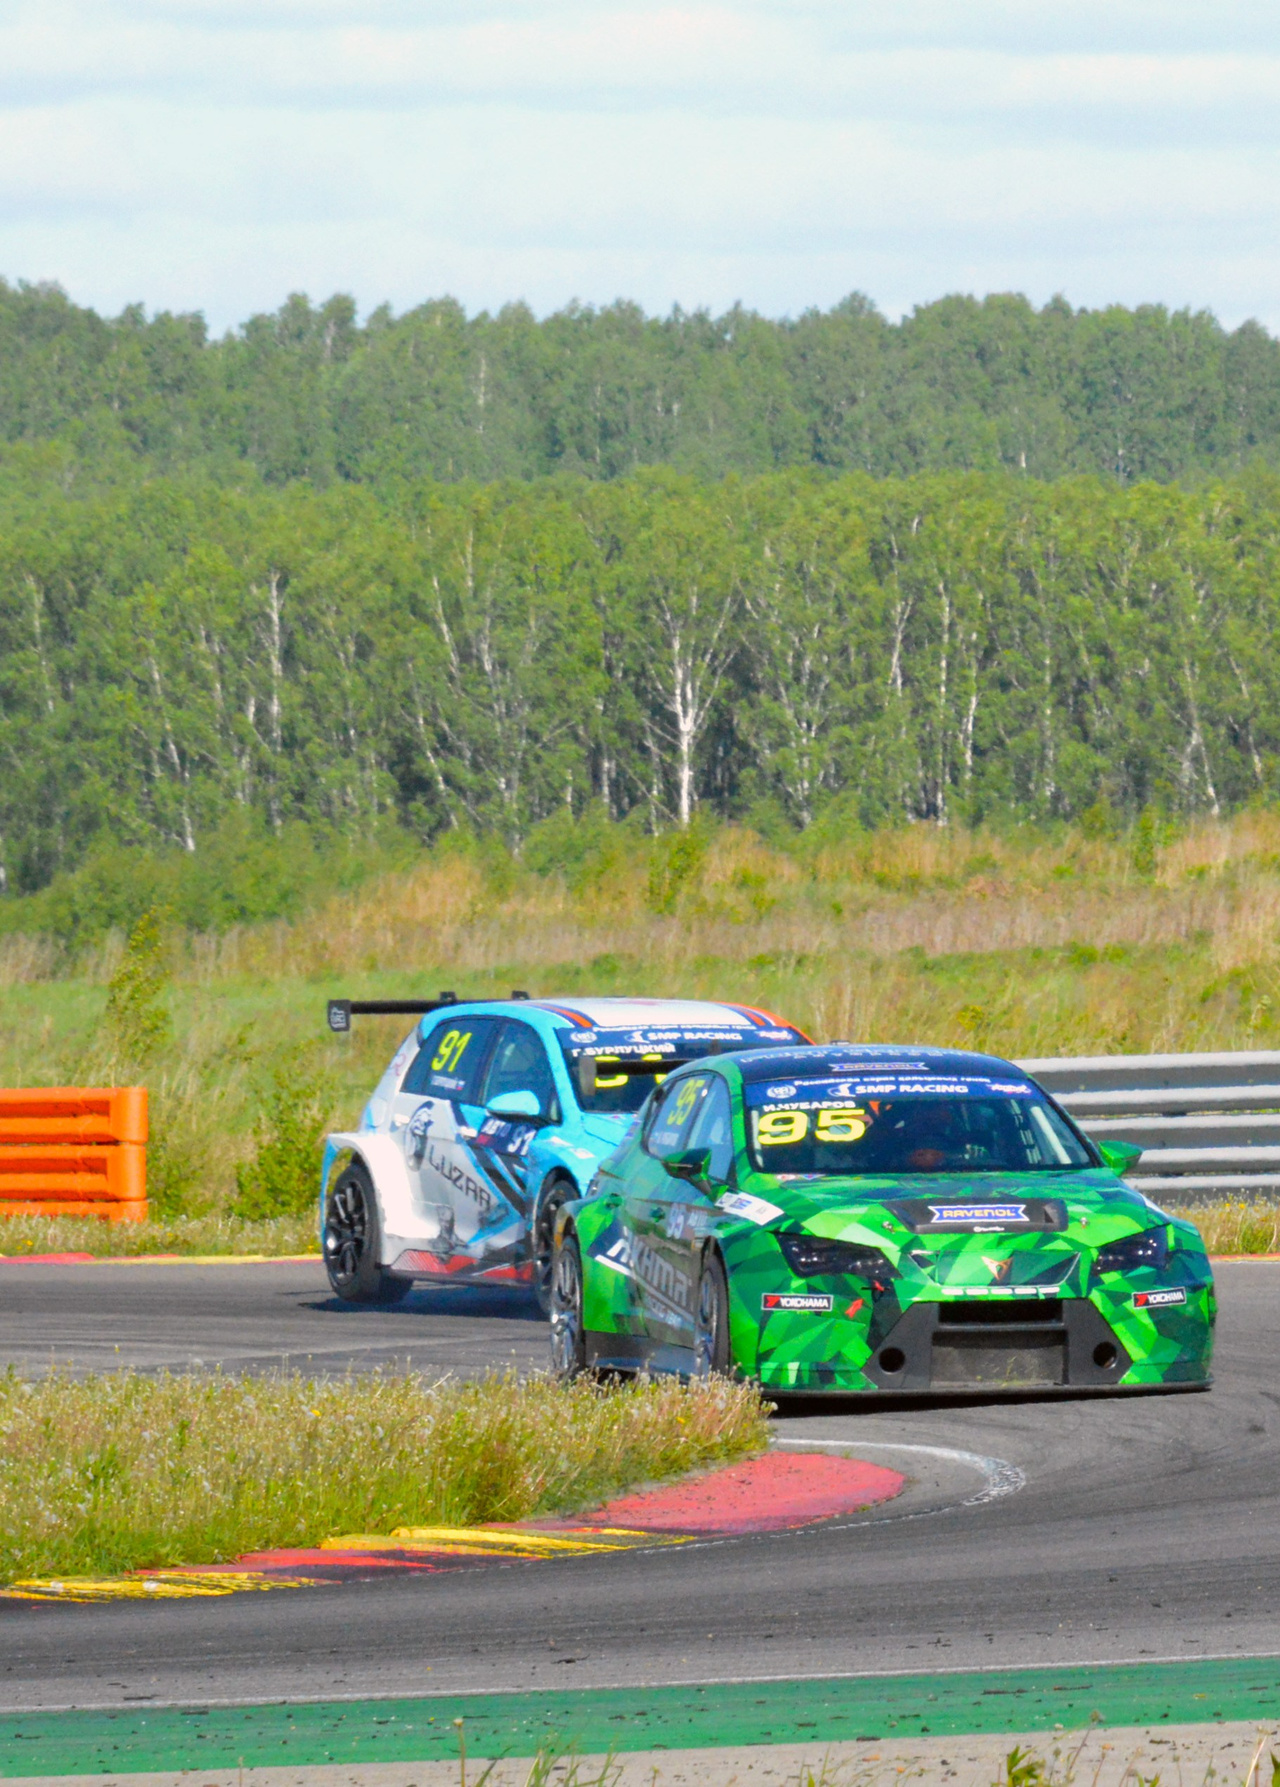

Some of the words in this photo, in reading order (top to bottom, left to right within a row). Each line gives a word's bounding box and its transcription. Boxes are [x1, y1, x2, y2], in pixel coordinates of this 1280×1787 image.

[647, 1032, 682, 1041] SMP
[684, 1032, 743, 1041] RACING
[431, 1030, 472, 1072] 91
[855, 1084, 896, 1093] SMP
[899, 1084, 969, 1094] RACING
[667, 1079, 705, 1126] 95
[762, 1100, 857, 1112] И.ЧУБАРОВ
[757, 1108, 866, 1146] 95
[943, 1209, 1016, 1217] RAVENOL
[780, 1296, 829, 1309] YOKOHAMA
[1149, 1290, 1185, 1305] YOKOHAMA
